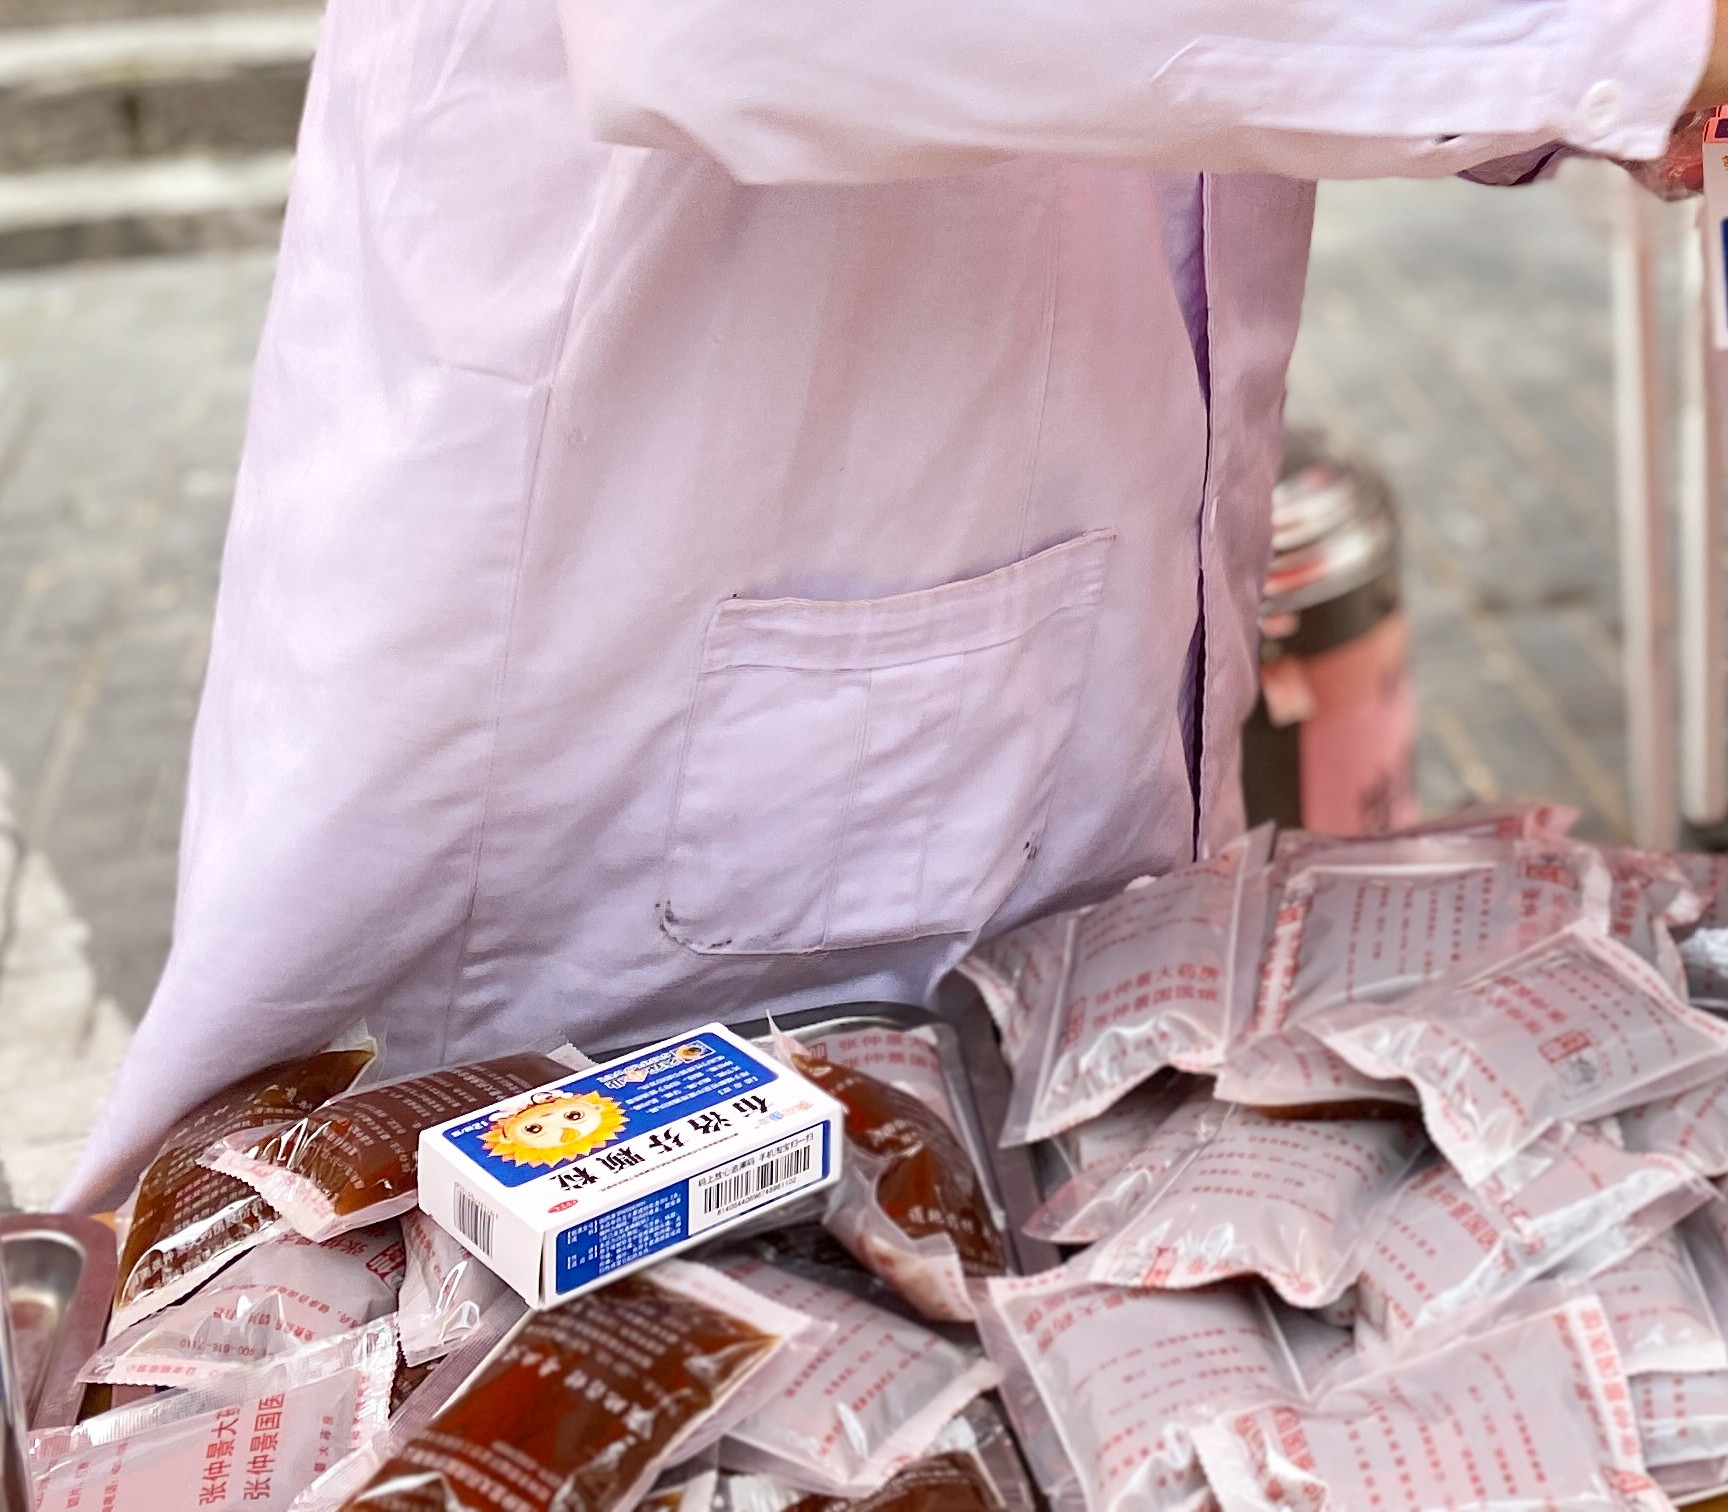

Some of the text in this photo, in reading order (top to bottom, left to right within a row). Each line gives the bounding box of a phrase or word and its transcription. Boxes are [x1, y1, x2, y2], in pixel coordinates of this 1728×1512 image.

[548, 1093, 770, 1192] 布洛芬颗粒
